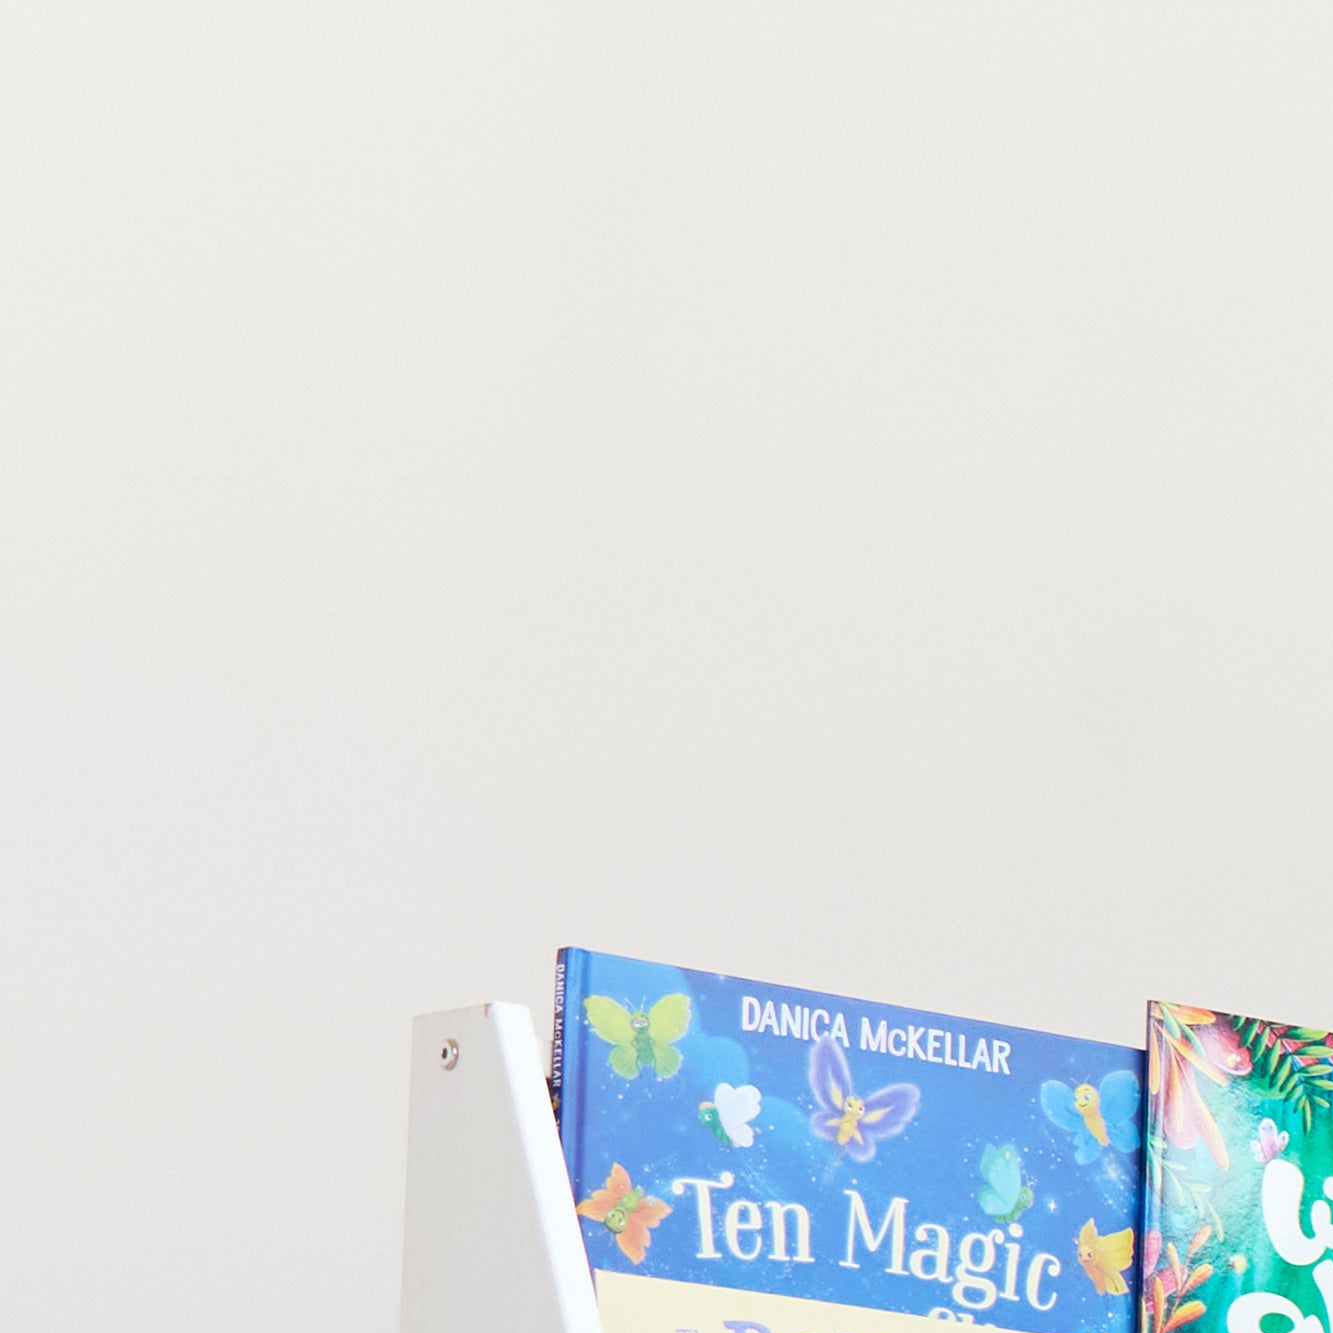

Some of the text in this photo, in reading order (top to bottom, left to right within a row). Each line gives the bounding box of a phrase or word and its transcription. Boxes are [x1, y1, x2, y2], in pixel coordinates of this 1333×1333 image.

[555, 964, 565, 1014] DANICA
[742, 996, 850, 1048] DANICA
[671, 1171, 1061, 1311] Ten Magic
